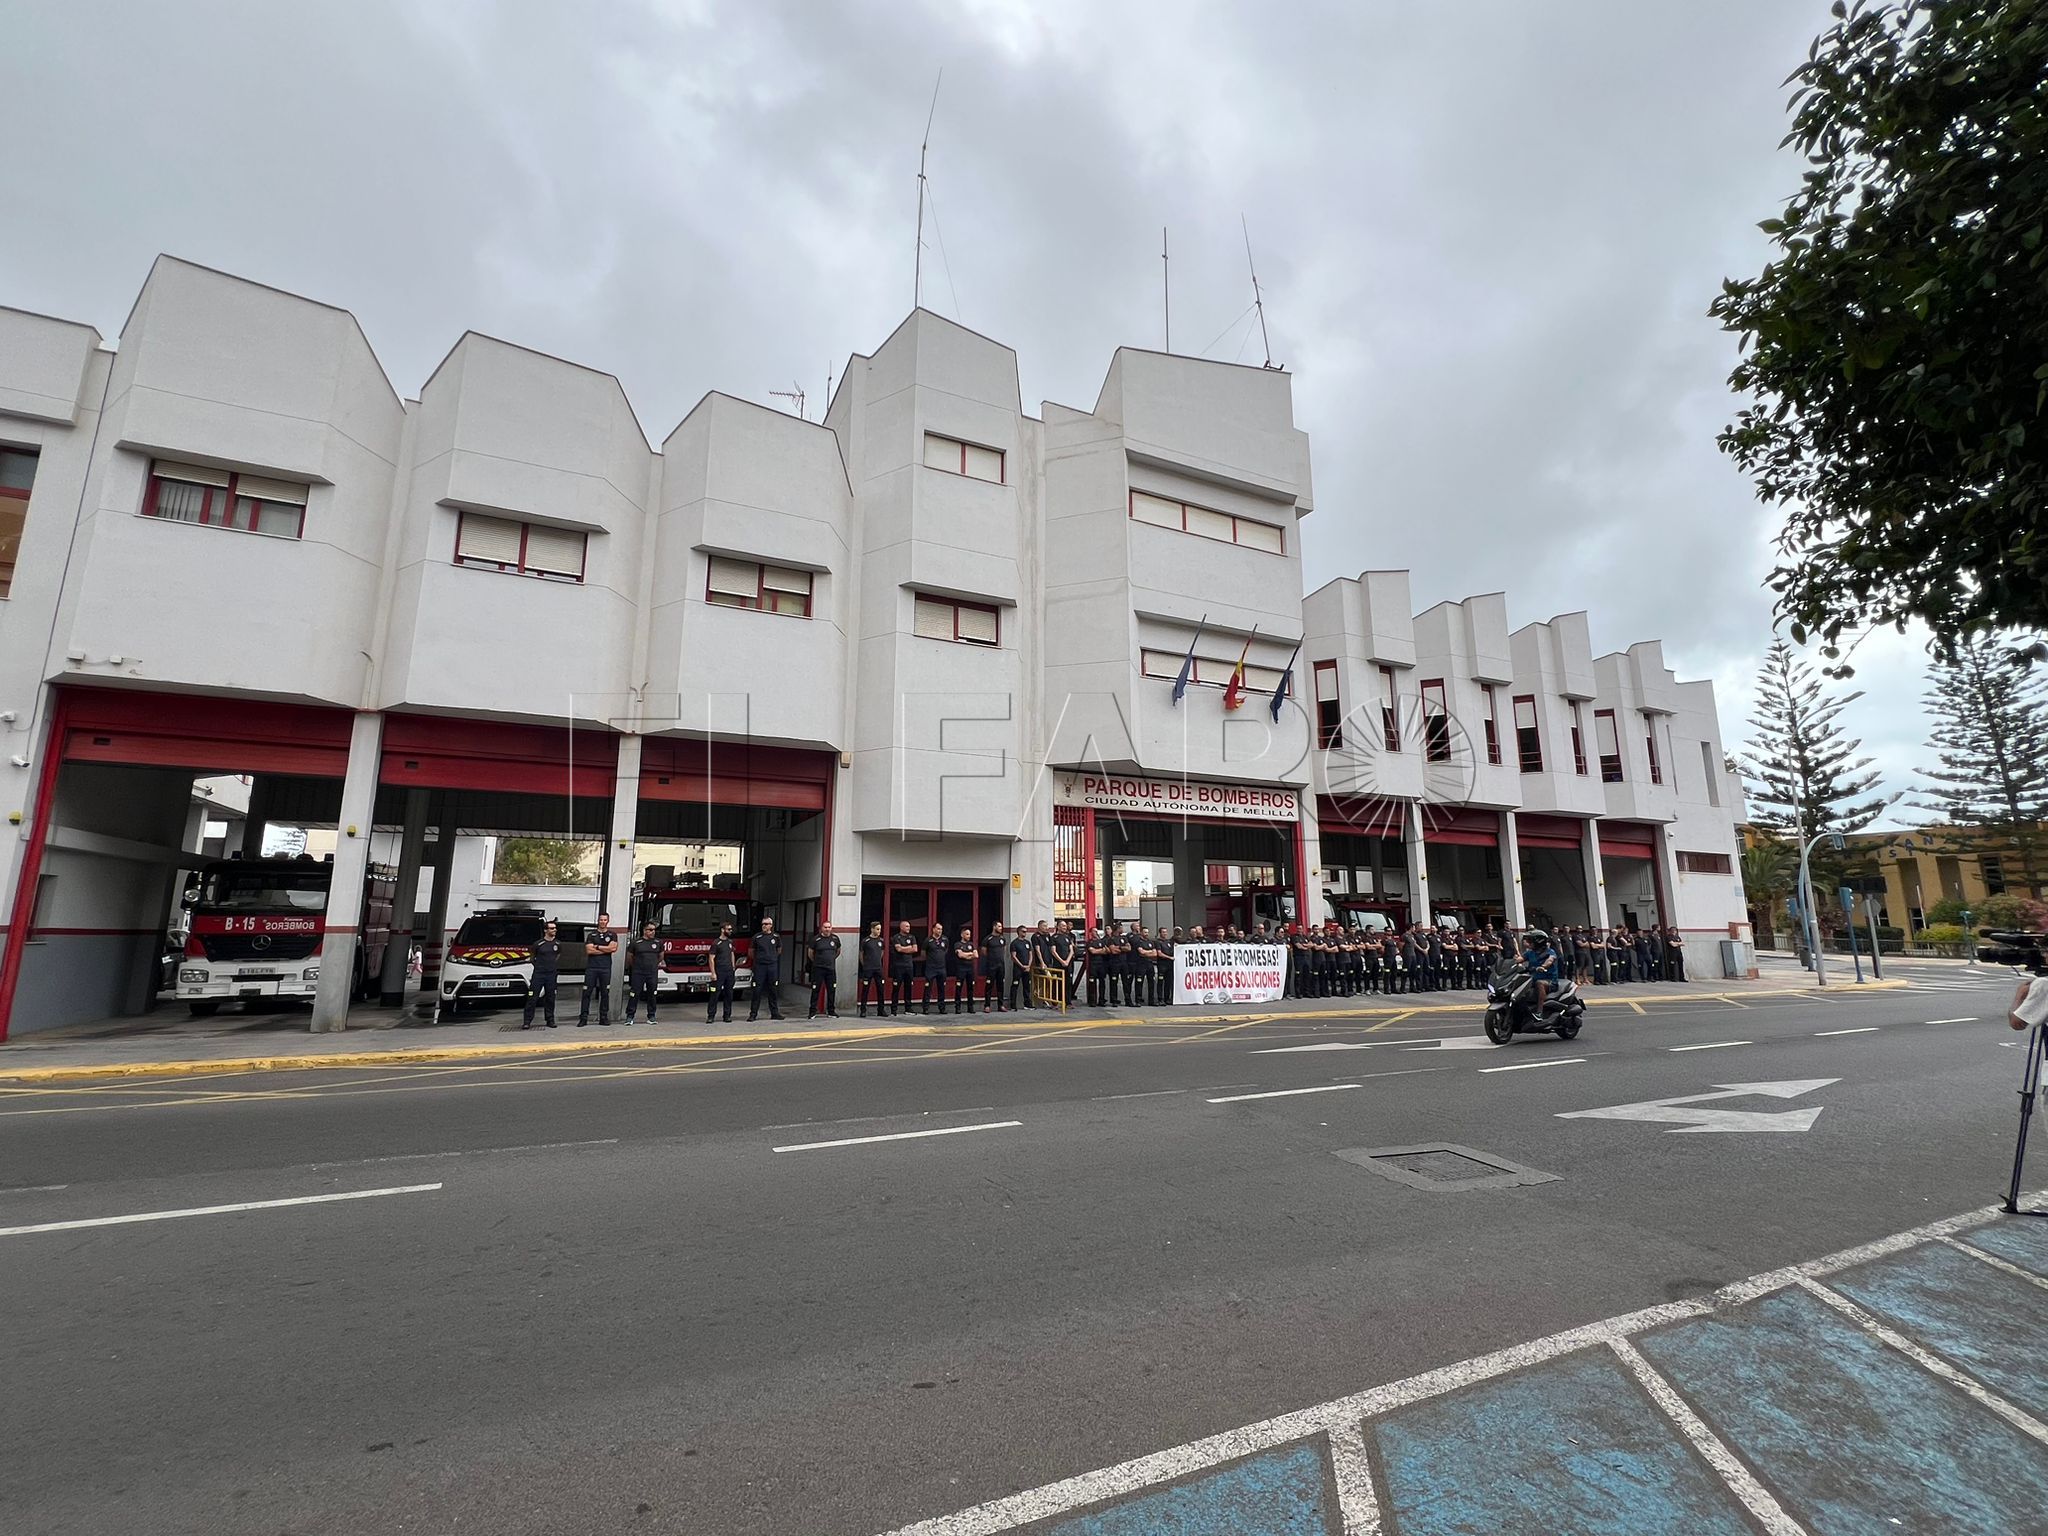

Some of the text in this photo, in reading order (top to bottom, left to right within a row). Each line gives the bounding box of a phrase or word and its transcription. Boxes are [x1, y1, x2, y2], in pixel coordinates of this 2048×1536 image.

[1084, 778, 1295, 809] PARQUE DE BOMBEROS
[1084, 796, 1139, 807] CIUDAD
[1143, 801, 1219, 813] AUTÓNOMA
[1243, 808, 1295, 817] MELILLA
[225, 917, 233, 930] B
[243, 917, 255, 930] 15
[1185, 948, 1279, 967] ¡BASTA DE PROMESAS!
[1184, 970, 1280, 990] QUEREMOS SOLUCIONES
